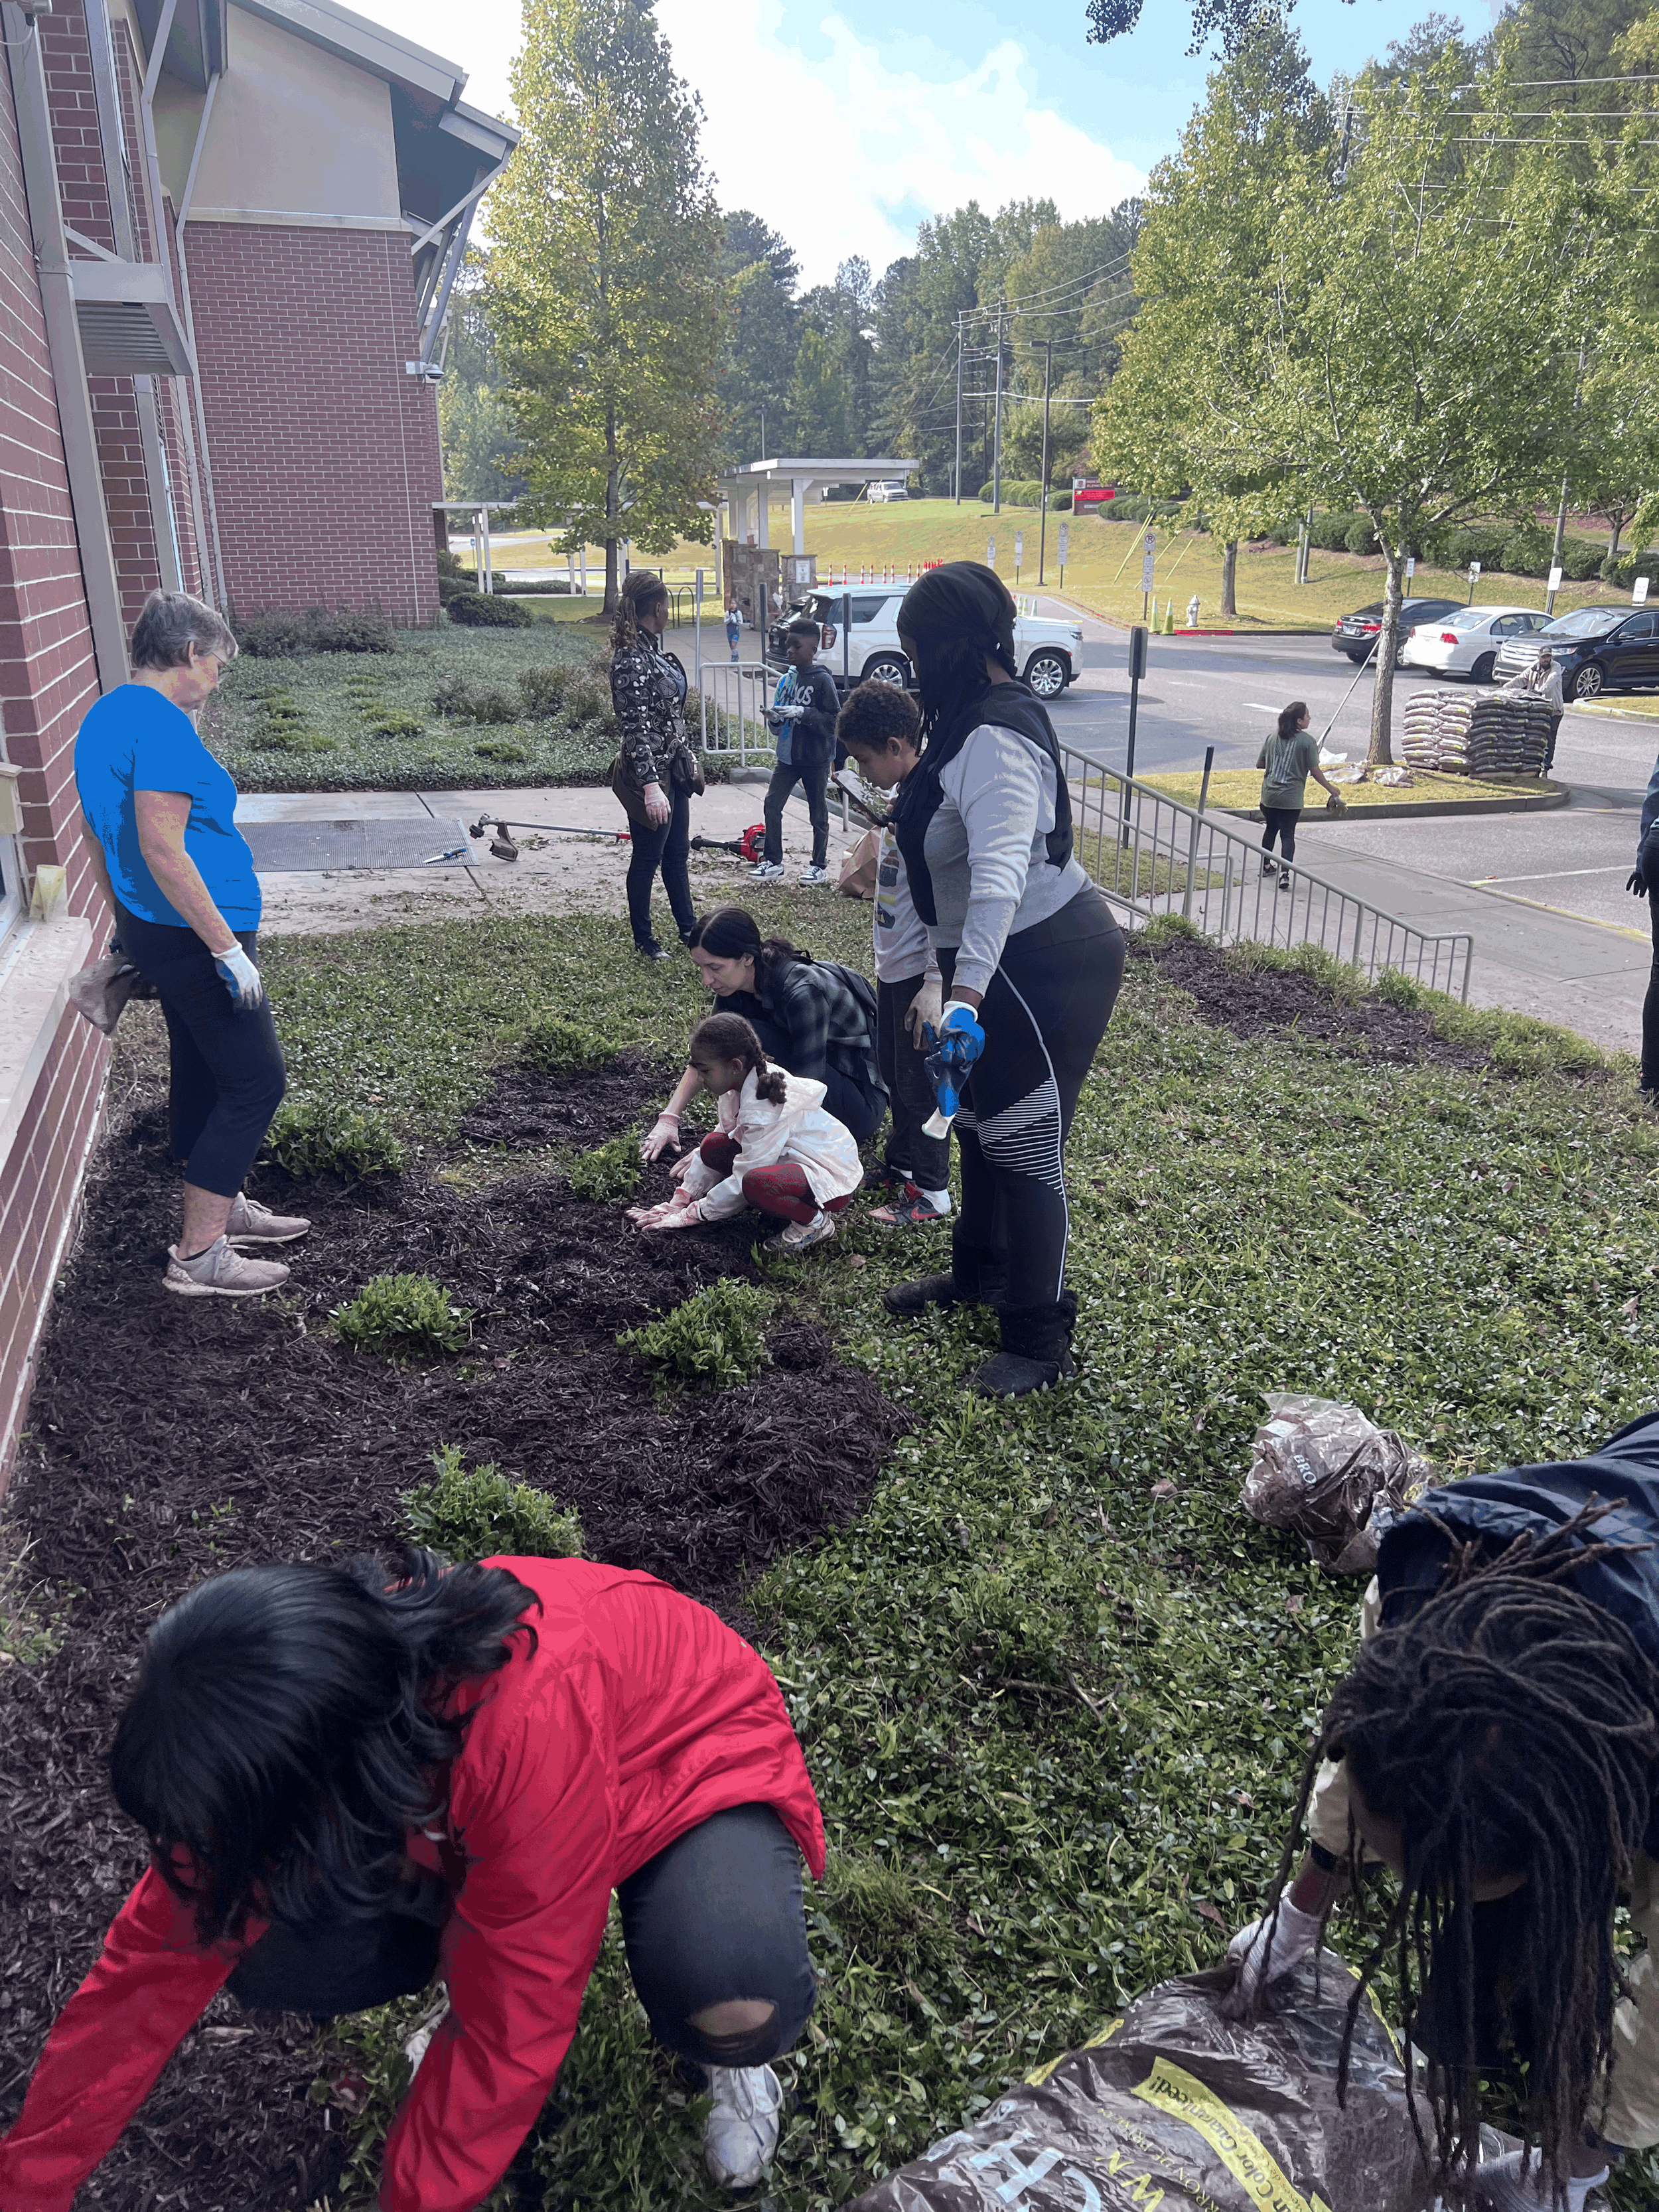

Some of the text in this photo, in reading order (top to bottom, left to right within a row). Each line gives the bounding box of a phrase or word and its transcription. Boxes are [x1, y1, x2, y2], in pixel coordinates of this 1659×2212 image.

[1293, 1454, 1317, 1485] BRO
[1149, 2075, 1237, 2152] Guaranteed!
[1236, 2153, 1274, 2198] Color
